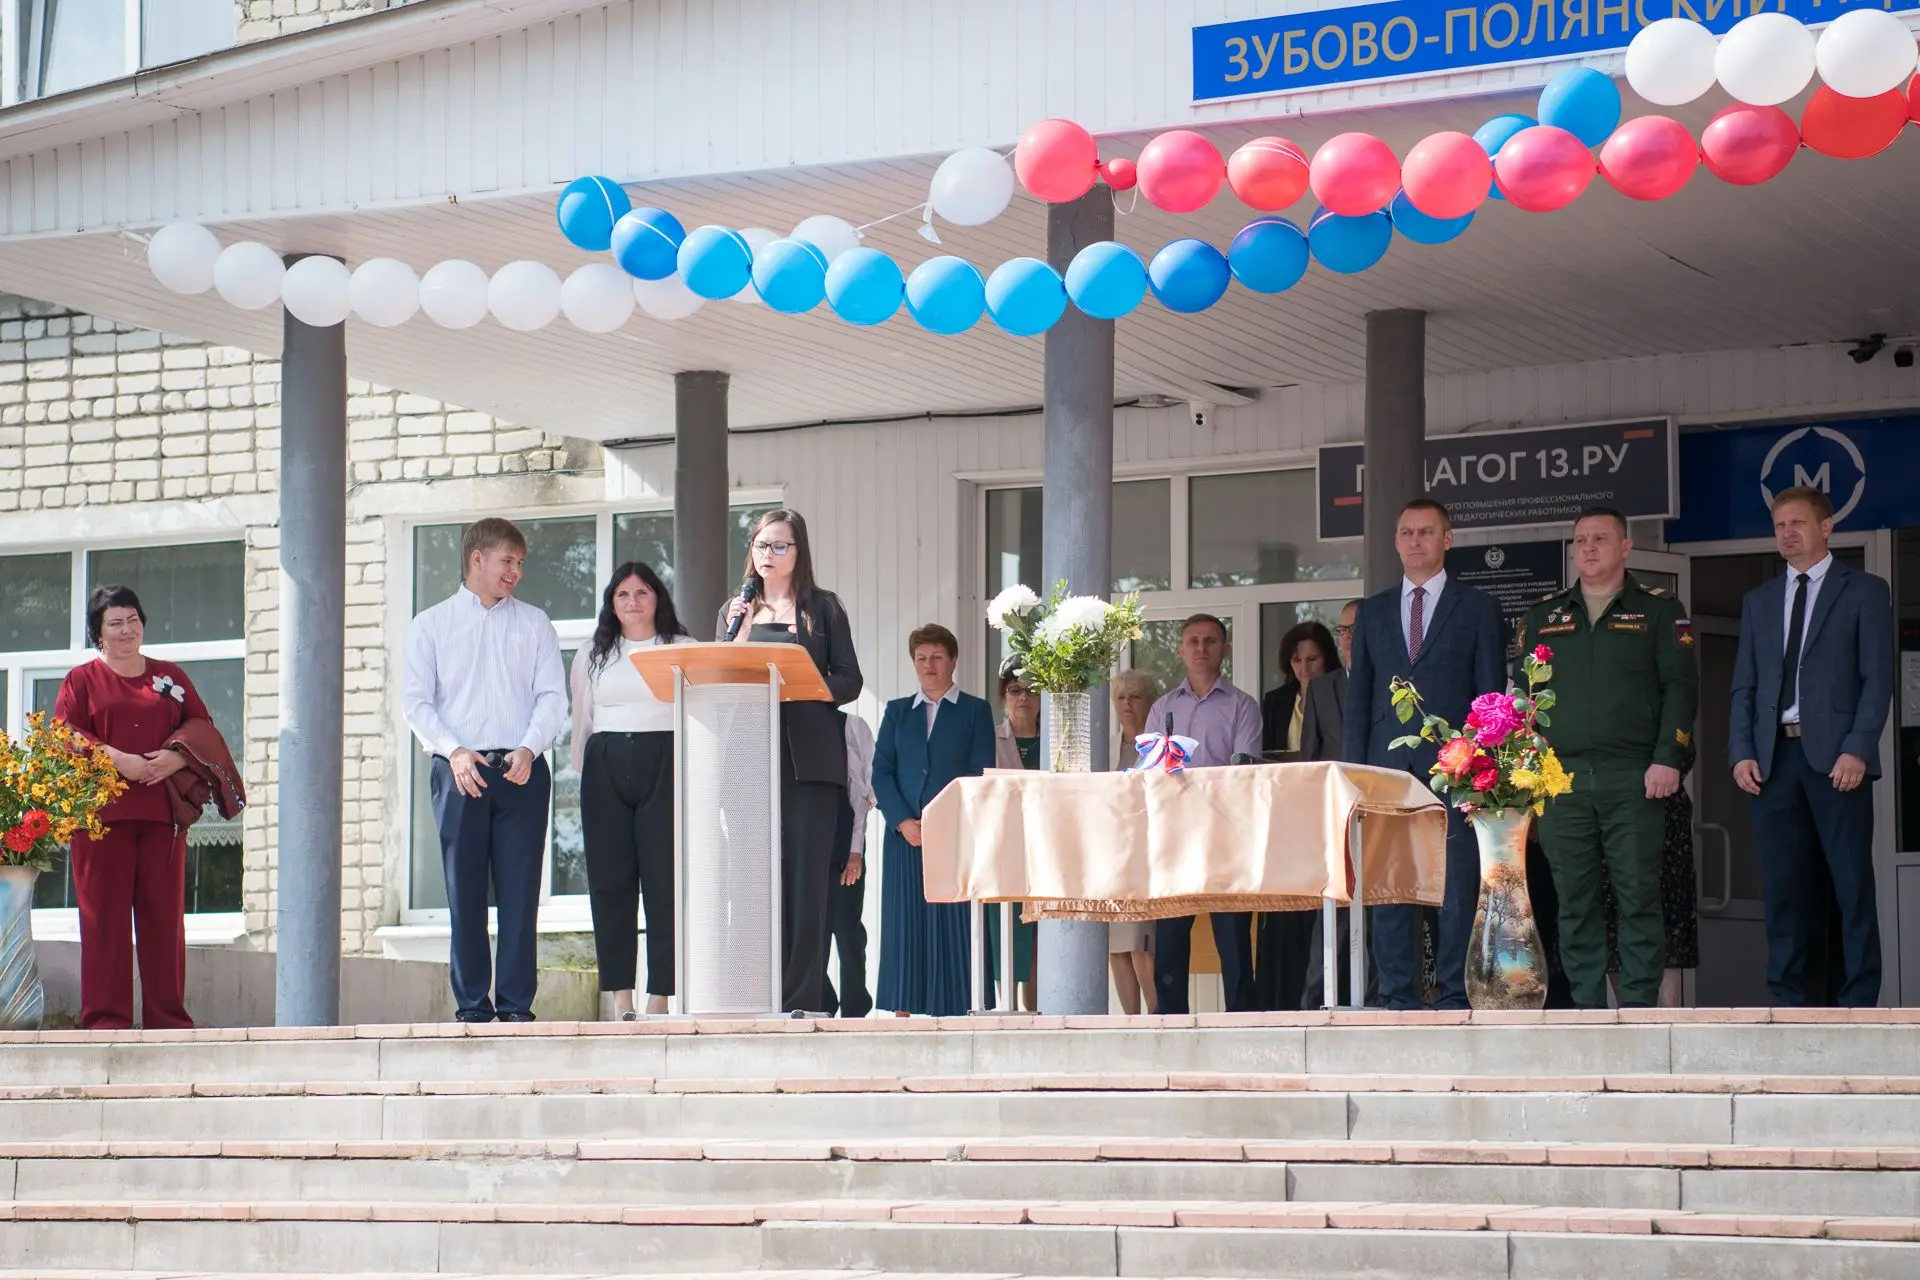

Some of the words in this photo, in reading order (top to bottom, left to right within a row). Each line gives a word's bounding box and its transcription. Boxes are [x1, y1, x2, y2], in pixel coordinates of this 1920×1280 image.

[1223, 0, 1787, 83] ЗУБОВО-ПОЛЯНСК
[1535, 443, 1630, 480] 13.РУ
[1453, 510, 1527, 522] ПЕДАГОГИЧЕСКИХ
[1528, 505, 1583, 516] РАБОТНИКОВ
[1462, 498, 1516, 510] ПОВЫШЕНИЯ
[1517, 491, 1614, 506] ПРОФЕССИОНАЛЬНОГО
